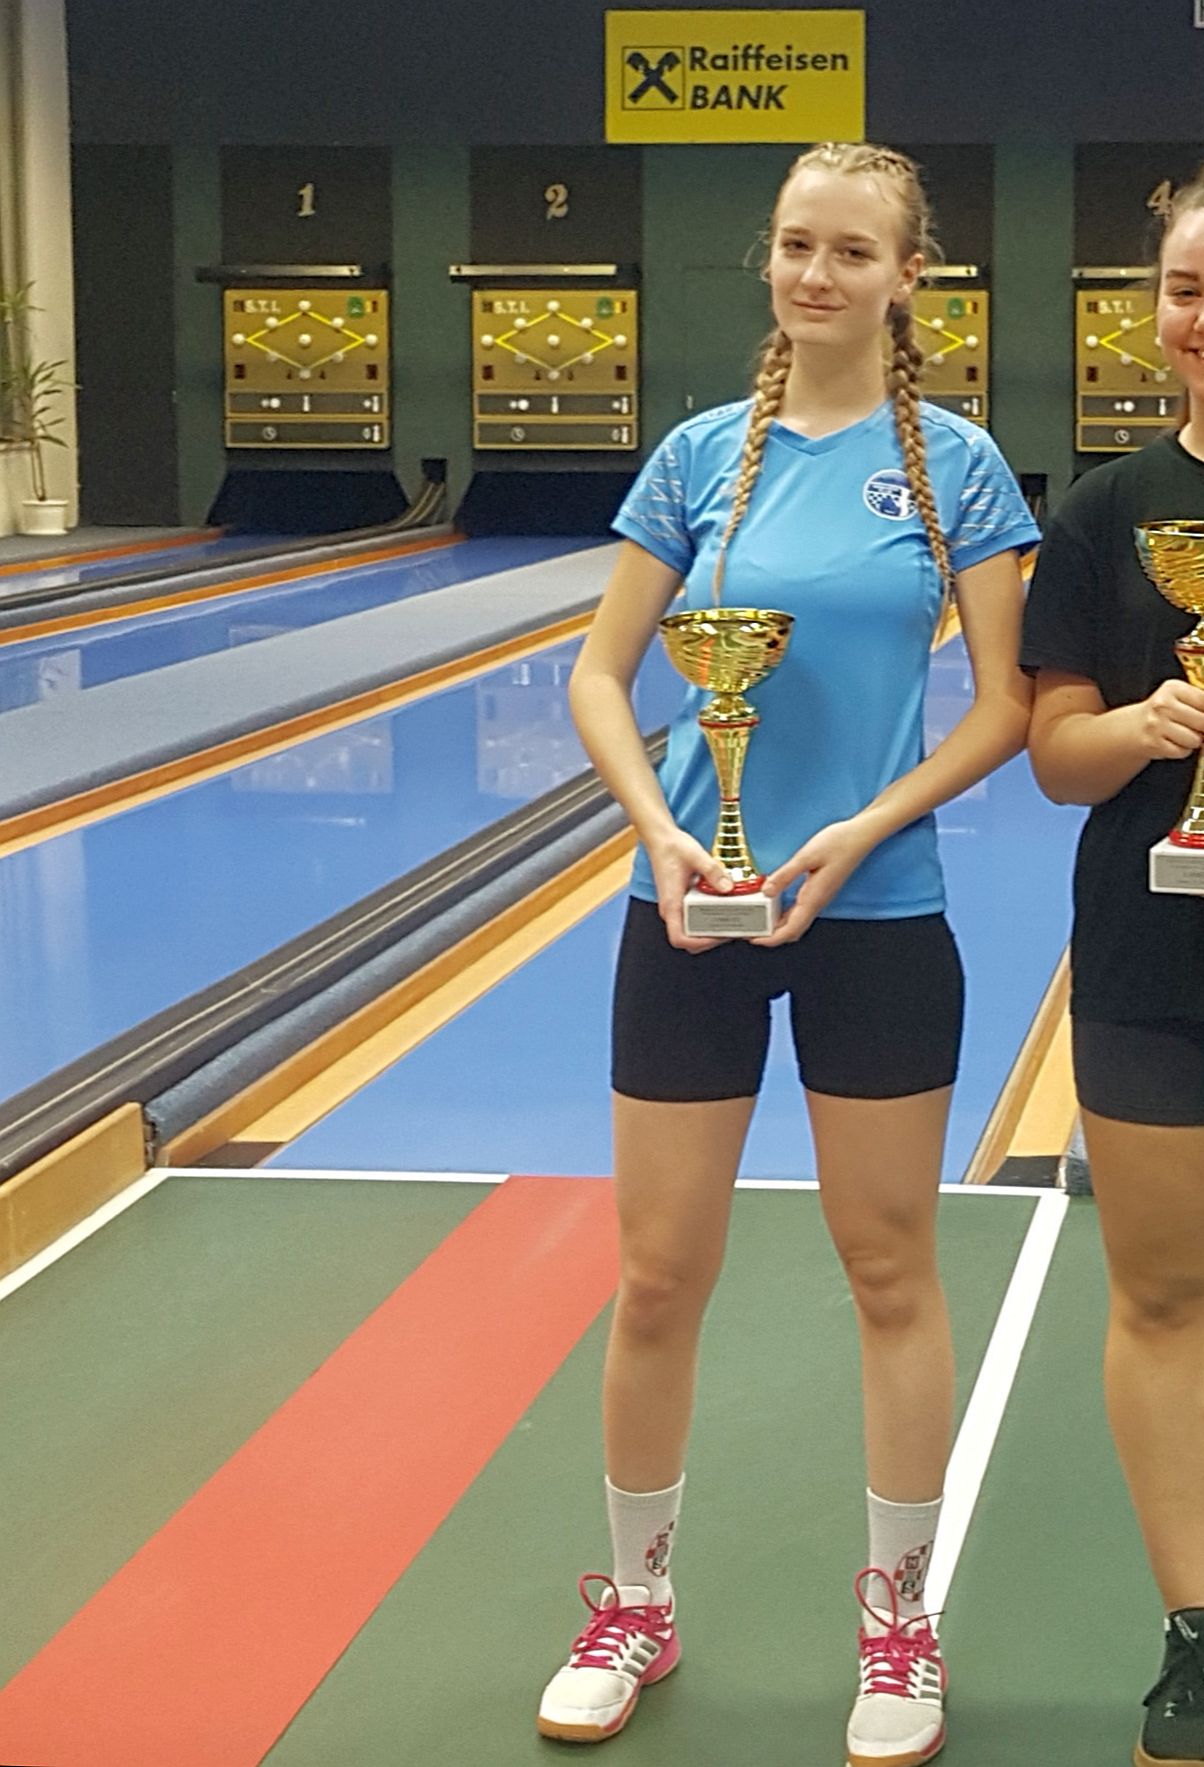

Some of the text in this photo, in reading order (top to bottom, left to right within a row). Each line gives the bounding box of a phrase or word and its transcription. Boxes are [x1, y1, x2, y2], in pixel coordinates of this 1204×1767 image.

[689, 44, 849, 72] Raiffeisen
[689, 84, 789, 110] BANK
[297, 182, 316, 217] 1
[544, 183, 569, 220] 2
[1146, 179, 1171, 216] 4
